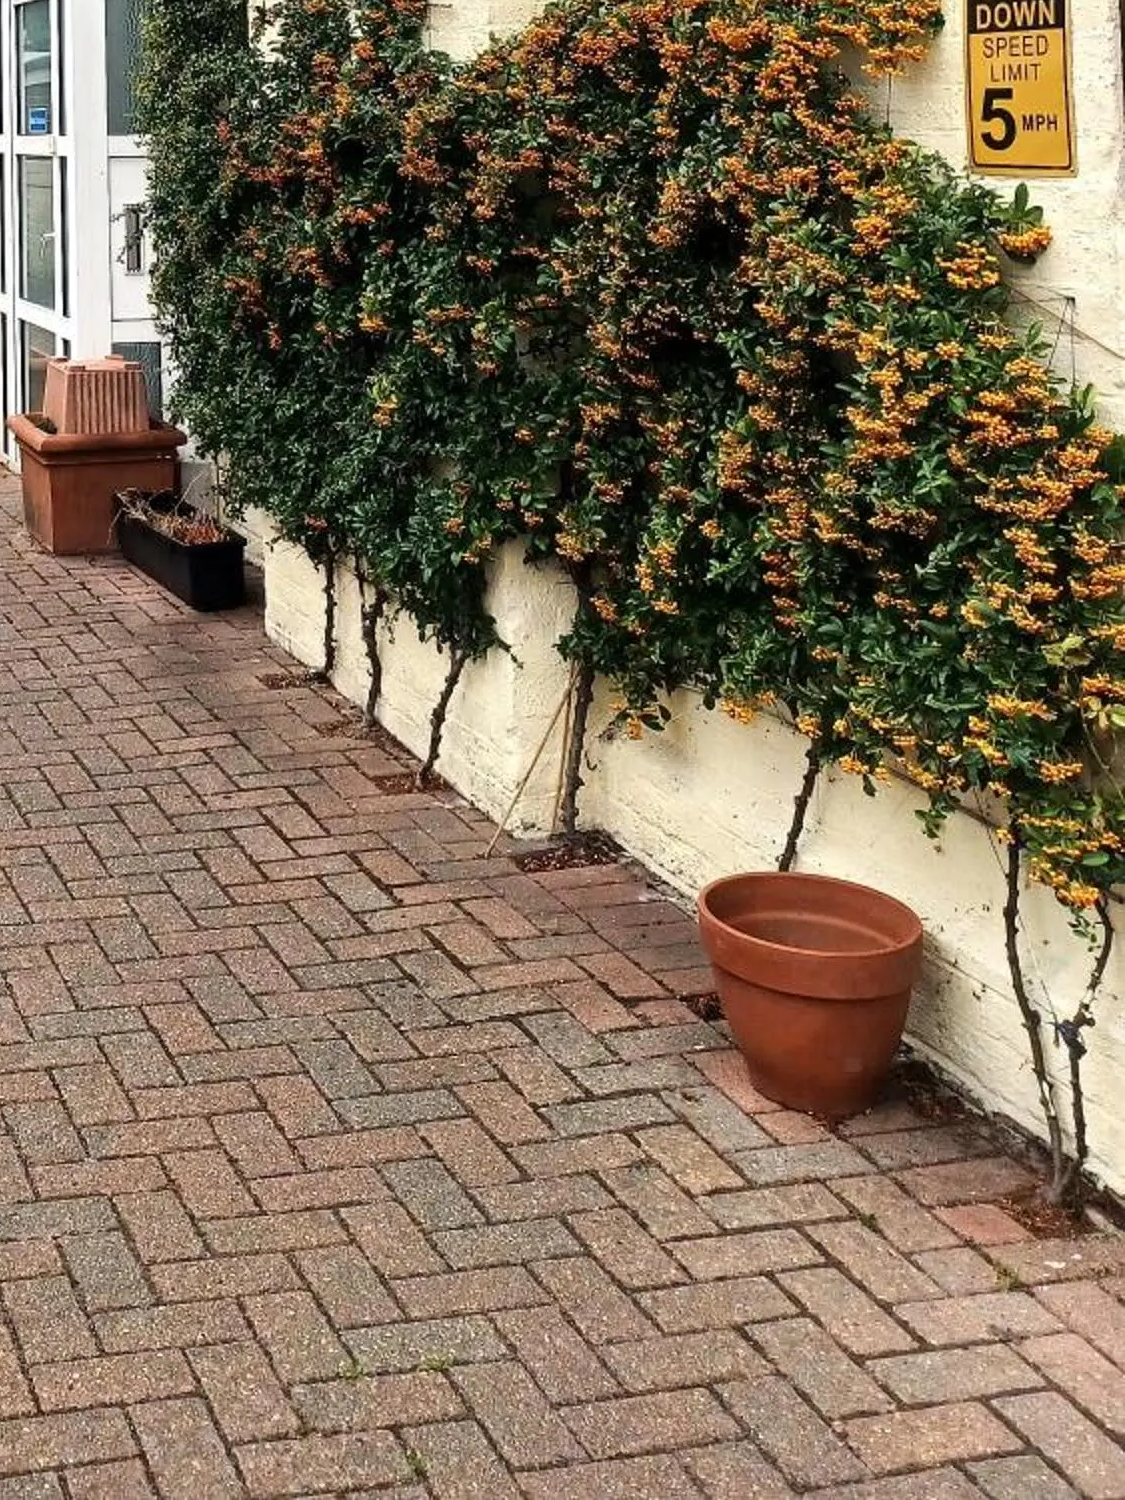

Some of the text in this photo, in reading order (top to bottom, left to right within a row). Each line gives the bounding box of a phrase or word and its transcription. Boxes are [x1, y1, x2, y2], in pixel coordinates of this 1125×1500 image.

[976, 0, 1056, 30] DOWN
[982, 35, 1050, 59] SPEED
[990, 63, 1042, 82] LIMIT
[980, 87, 1058, 151] 5 MPH
